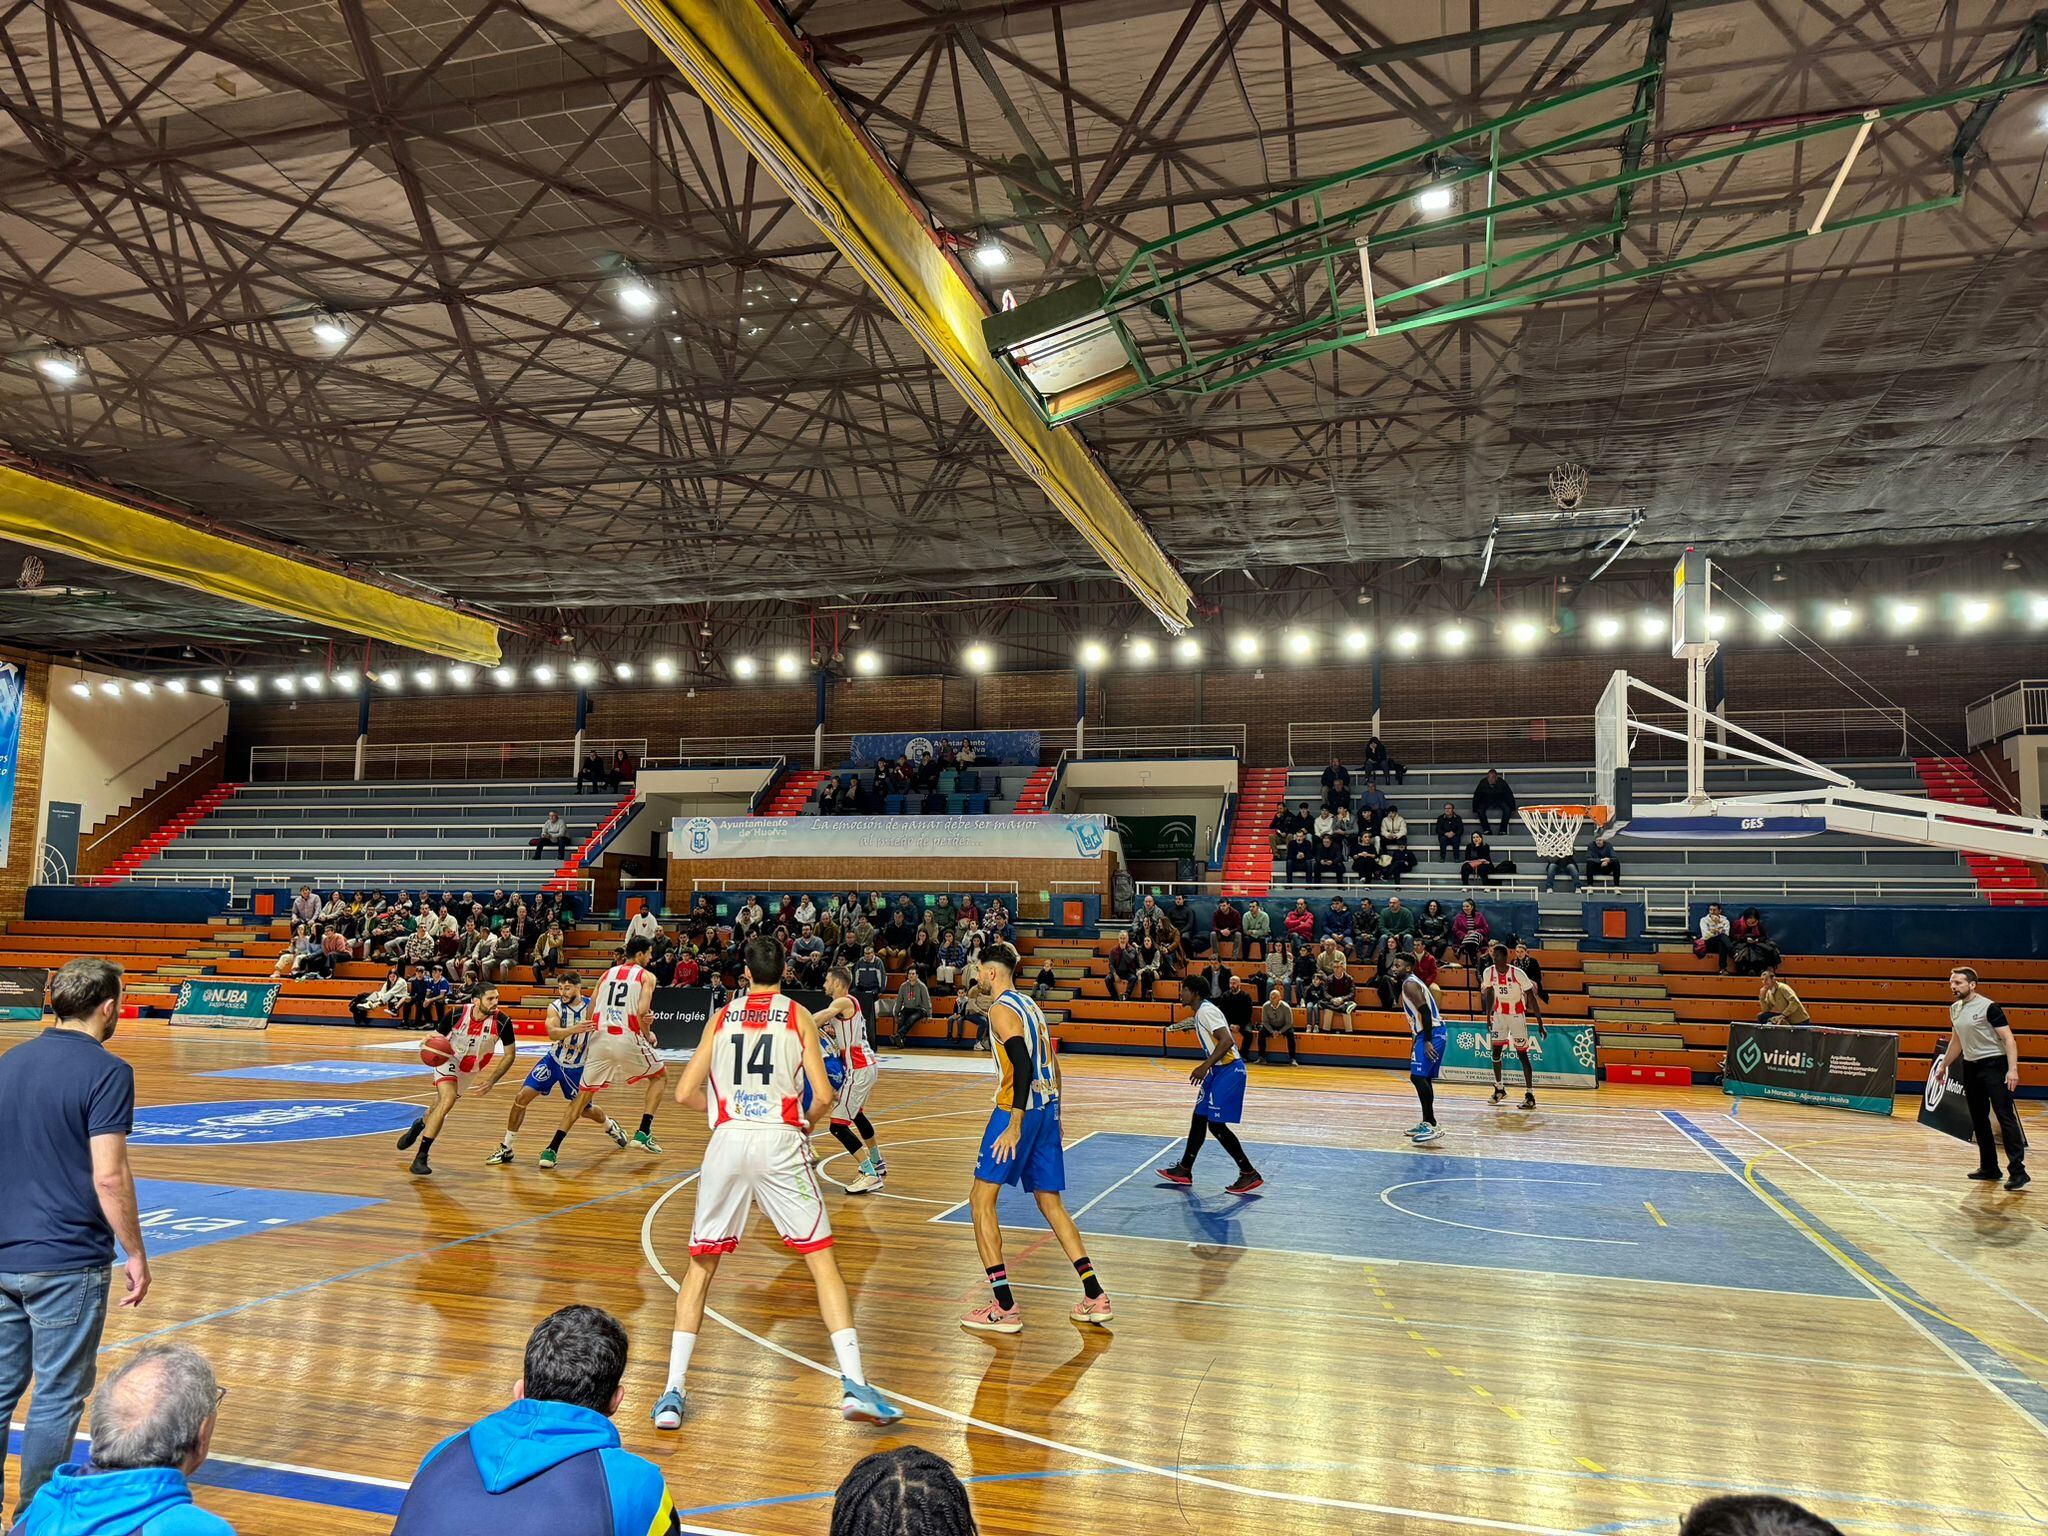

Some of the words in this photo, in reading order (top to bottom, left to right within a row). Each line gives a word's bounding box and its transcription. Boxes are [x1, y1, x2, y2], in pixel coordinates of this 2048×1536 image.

[720, 818, 788, 830] Ayuntamiento
[810, 818, 829, 831] La
[832, 816, 882, 831] emoción
[885, 817, 899, 833] de
[901, 819, 943, 833] ganar
[944, 815, 971, 833] debe
[973, 819, 992, 830] ser
[993, 819, 1039, 834] mayor
[1740, 817, 1765, 830] GES
[738, 828, 751, 837] de
[753, 828, 788, 837] Huelva
[915, 833, 929, 849] de
[211, 988, 248, 1004] NUBA
[607, 981, 628, 1007] 12
[652, 1010, 675, 1020] otor
[676, 1010, 706, 1023] Inglés
[723, 1009, 790, 1023] RODRIGUEZ
[468, 1038, 476, 1048] 2
[731, 1033, 774, 1085] 14
[1532, 1053, 1543, 1062] SL
[1763, 1049, 1815, 1069] viridis
[448, 1063, 456, 1073] 2
[1946, 1077, 1964, 1095] Motor
[1764, 1087, 1771, 1095] La
[1829, 1096, 1850, 1104] Huelva
